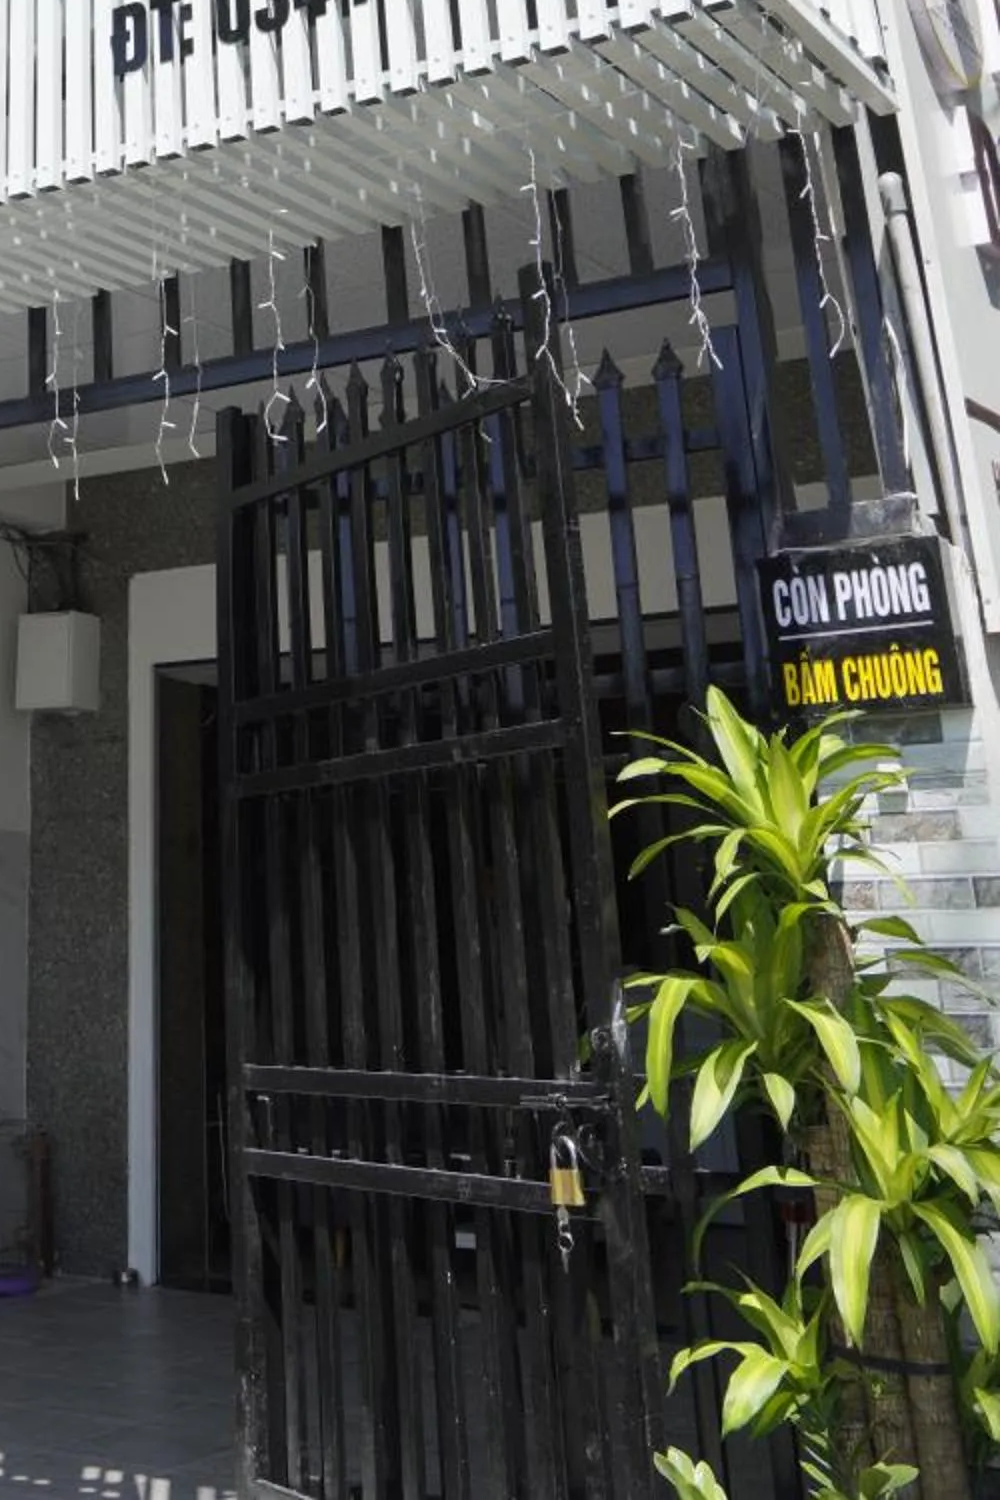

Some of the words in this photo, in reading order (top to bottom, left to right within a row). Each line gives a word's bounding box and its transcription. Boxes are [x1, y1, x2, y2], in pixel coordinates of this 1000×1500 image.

[772, 564, 831, 628] CÒN
[833, 553, 932, 622] PHÒNG
[842, 641, 944, 702] CHUÔNG
